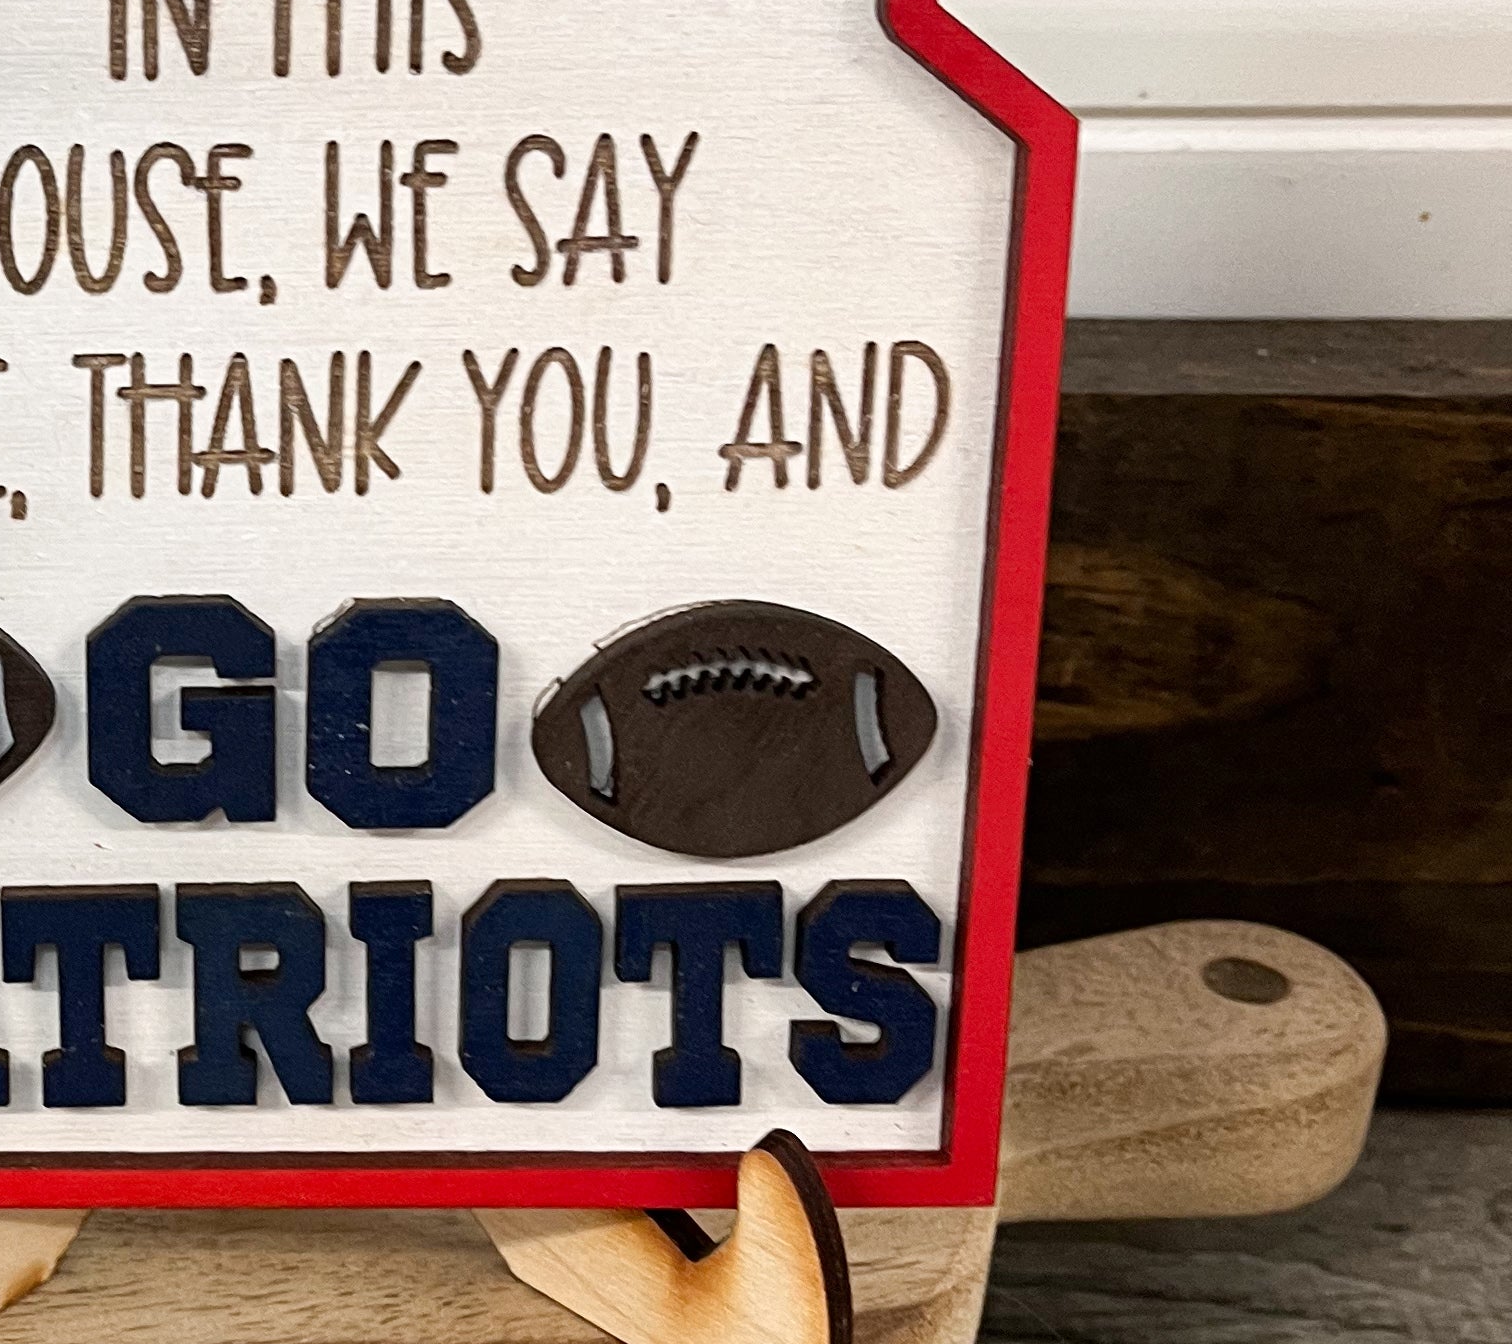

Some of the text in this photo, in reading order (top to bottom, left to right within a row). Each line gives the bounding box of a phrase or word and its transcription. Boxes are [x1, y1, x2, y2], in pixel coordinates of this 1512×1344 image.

[326, 139, 459, 290] WE
[505, 131, 699, 286] SAY
[72, 350, 422, 499] THANK
[463, 346, 670, 512] YOU,
[719, 341, 950, 492] AND
[85, 594, 500, 830] GO
